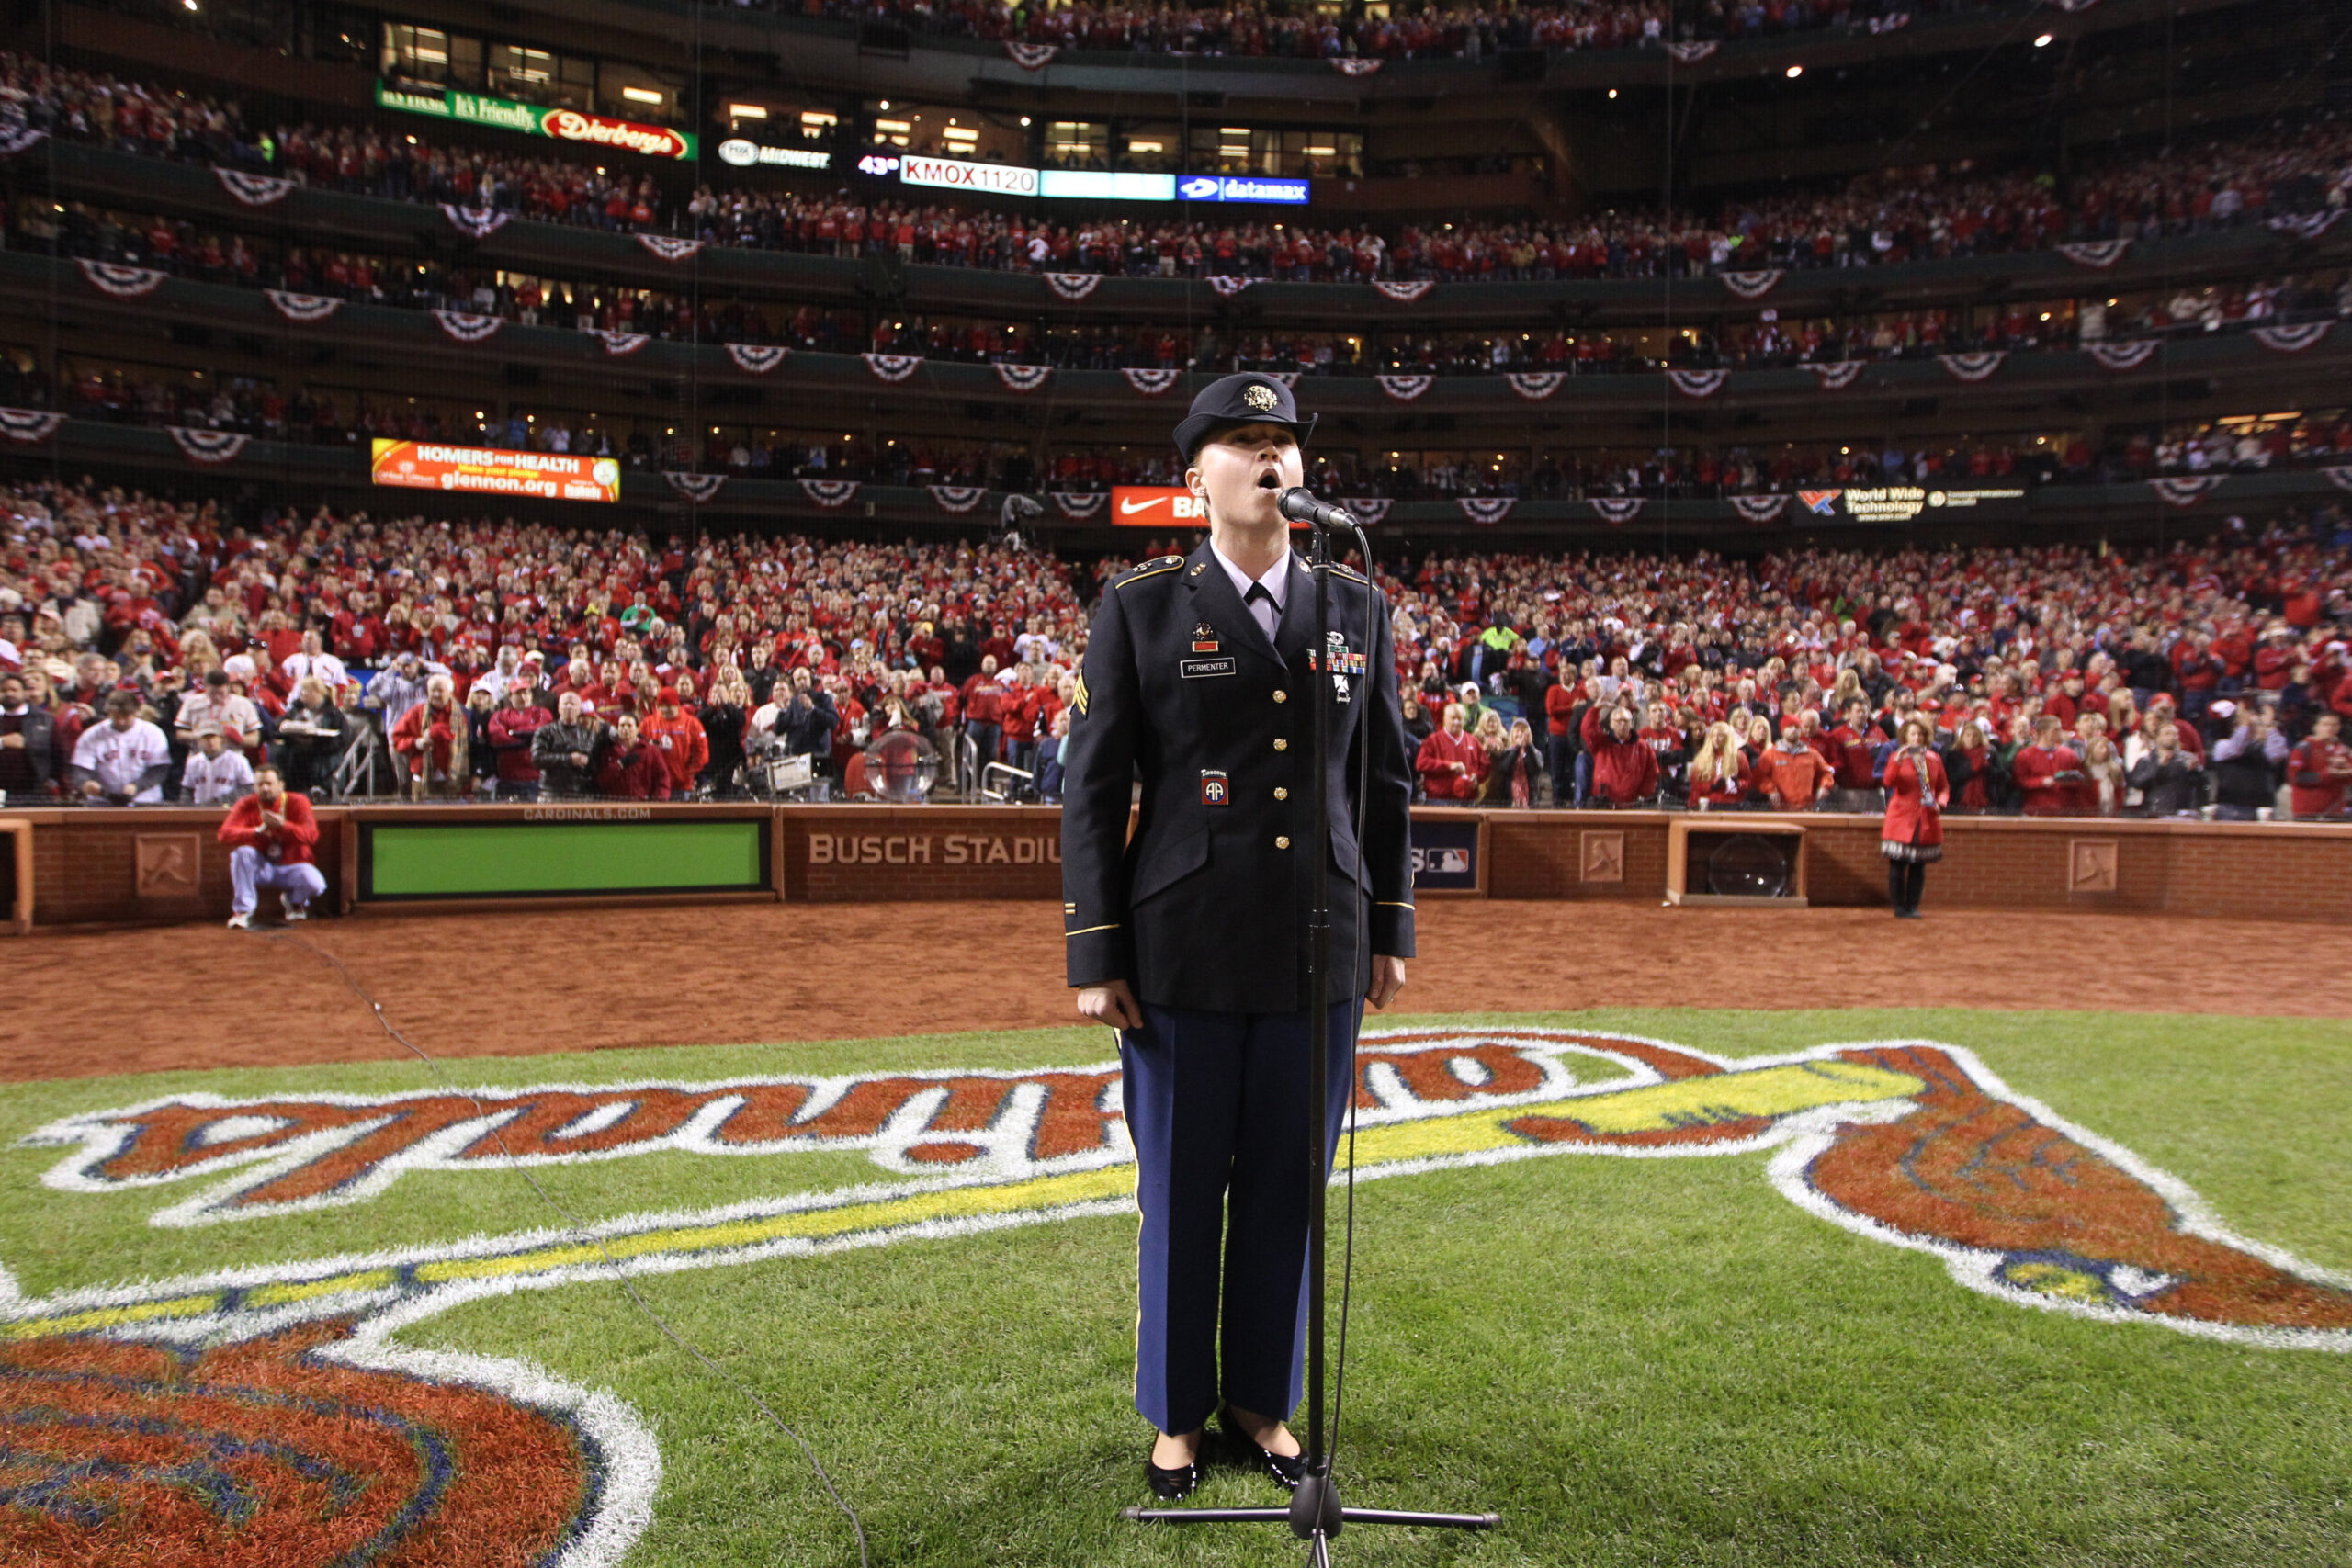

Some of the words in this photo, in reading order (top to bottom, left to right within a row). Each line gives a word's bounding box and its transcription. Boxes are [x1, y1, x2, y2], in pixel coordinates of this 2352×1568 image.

[558, 111, 673, 155] Dierbergs
[1225, 179, 1306, 201] datamax
[417, 445, 494, 467] HOMERS
[494, 455, 514, 466] FOR
[514, 454, 580, 475] HEALTH
[441, 470, 558, 499] glennon.org
[1844, 487, 1887, 502] World
[1888, 486, 1926, 501] Wide
[1845, 501, 1925, 516] Technology
[1187, 661, 1229, 672] PERMENTER
[1205, 781, 1224, 801] AA
[523, 808, 650, 821] CARDINALS.COM
[809, 833, 932, 864] BUSCH
[944, 834, 1062, 864] STADIU
